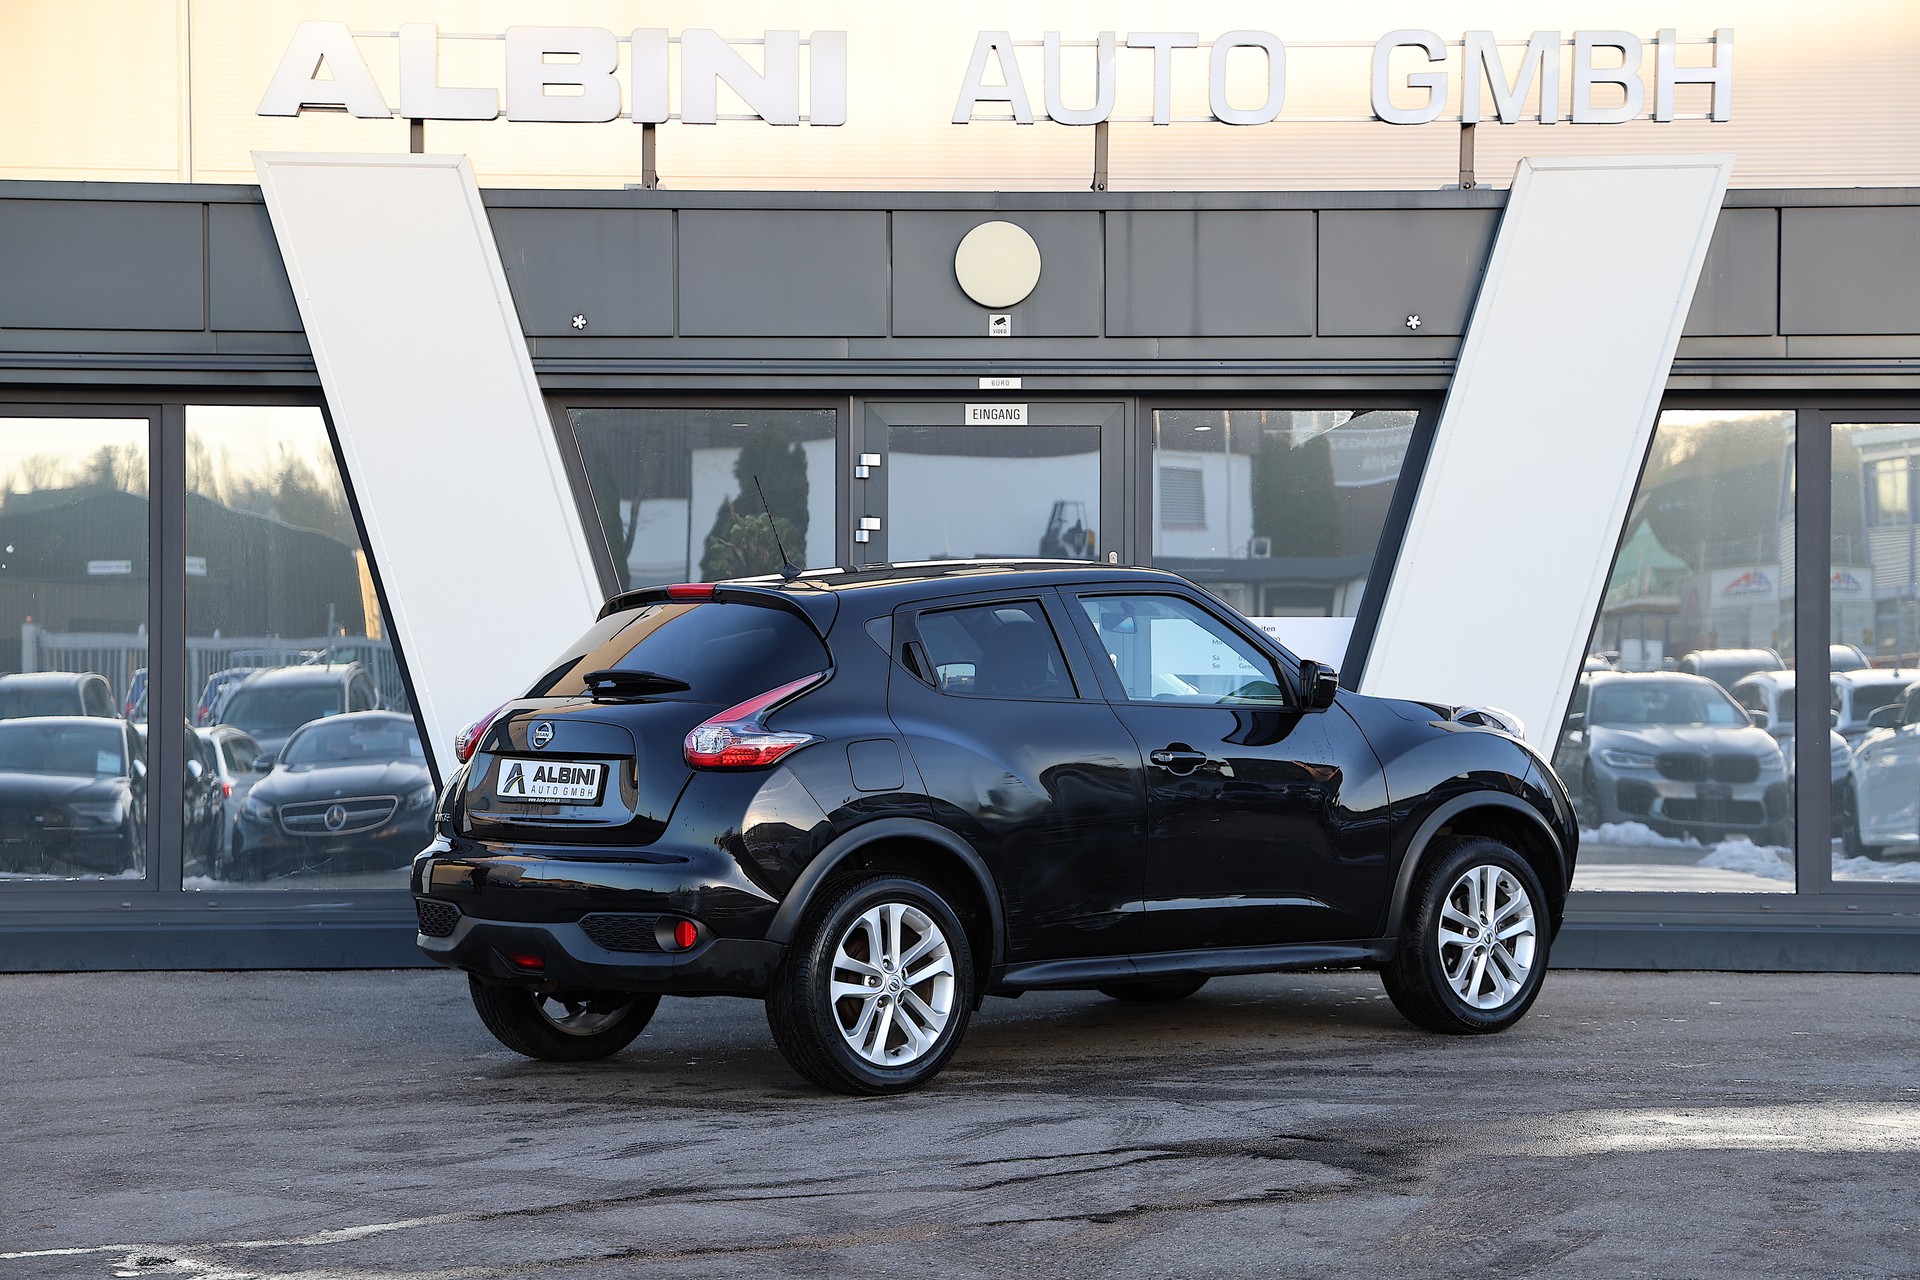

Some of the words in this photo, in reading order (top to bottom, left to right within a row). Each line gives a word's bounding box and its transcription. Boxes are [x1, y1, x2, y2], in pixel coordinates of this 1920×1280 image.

[256, 20, 848, 127] ALBINI
[951, 29, 1286, 127] AUTO
[1369, 27, 1735, 125] GMBH
[973, 408, 1020, 420] EINGANG
[533, 765, 596, 785] ALBINI
[530, 785, 559, 795] AUTO
[562, 787, 594, 797] GMBH
